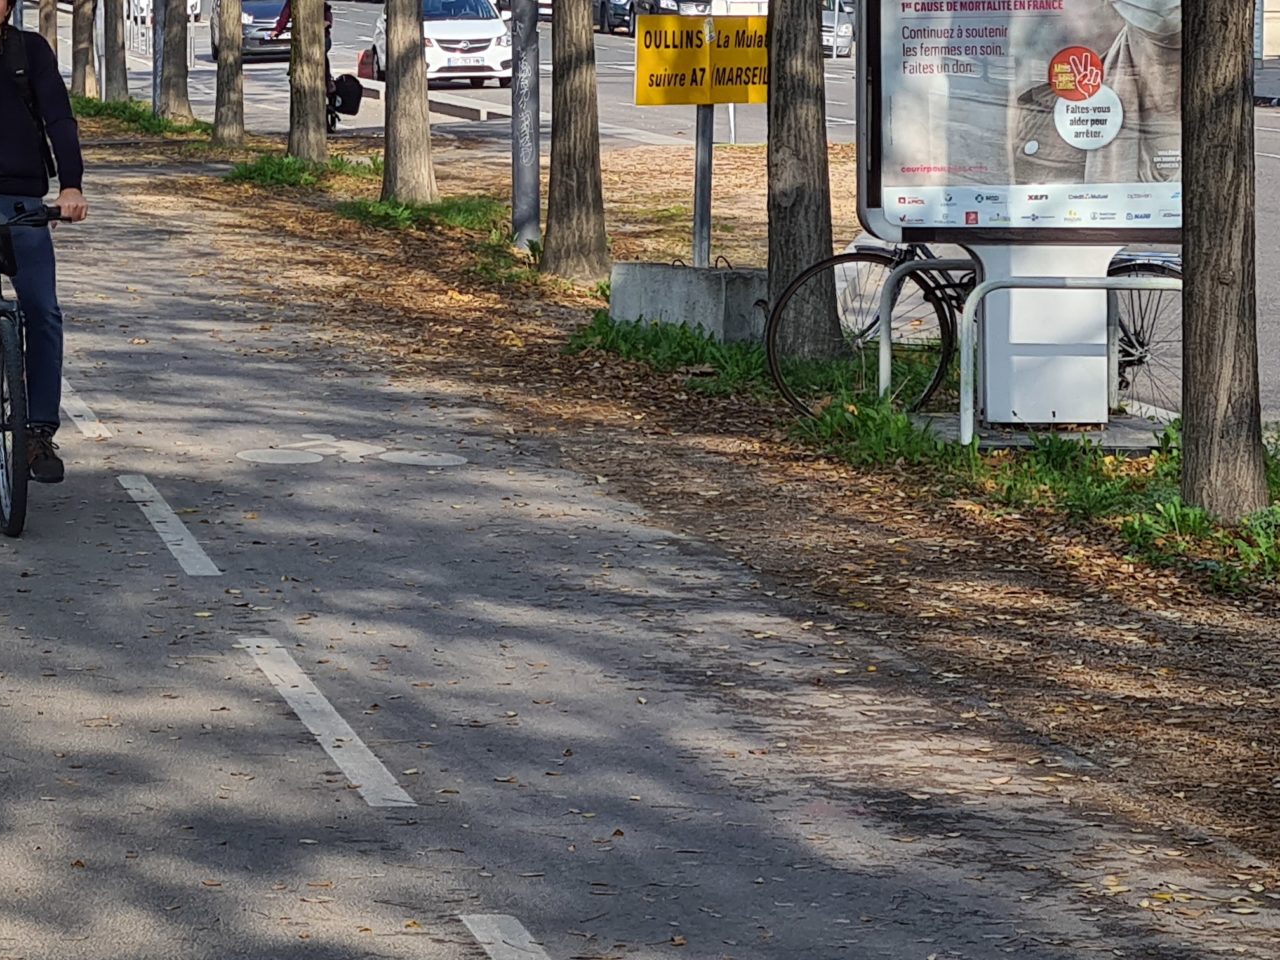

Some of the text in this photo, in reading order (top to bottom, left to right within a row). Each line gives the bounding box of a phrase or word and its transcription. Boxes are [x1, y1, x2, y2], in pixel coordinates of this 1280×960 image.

[914, 1, 945, 12] CAUSE
[946, 1, 959, 11] DE
[1013, 0, 1026, 10] EN
[1027, 0, 1063, 10] FRANCE
[902, 25, 1008, 40] Continuez à soutenir
[644, 30, 704, 49] OULLINS
[716, 30, 730, 48] La
[902, 43, 1005, 57] les femmes en soin.
[902, 61, 975, 74] Faites un don.
[648, 67, 686, 88] suivre
[690, 67, 706, 87] A7
[1066, 105, 1111, 115] Faites-vous
[1069, 118, 1108, 127] aider pour
